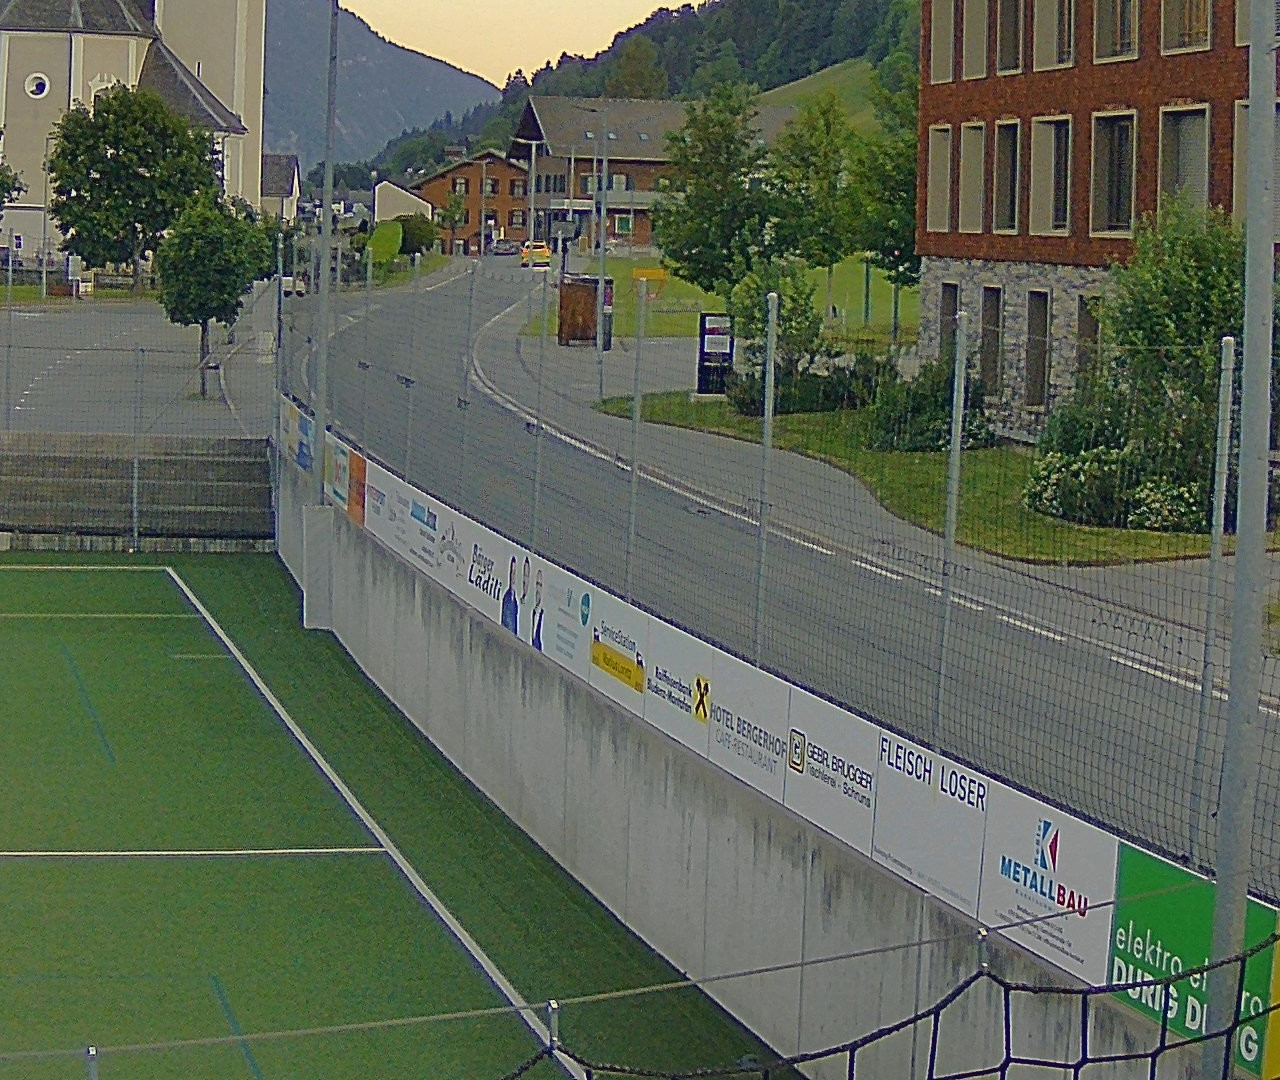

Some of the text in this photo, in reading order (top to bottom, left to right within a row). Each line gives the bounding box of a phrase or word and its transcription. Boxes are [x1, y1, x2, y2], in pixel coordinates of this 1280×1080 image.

[710, 702, 787, 760] HOTEL BERGERHOF
[806, 741, 873, 792] GEBR. BRUGGER
[880, 736, 987, 812] FLEISCH LOSER
[1000, 855, 1089, 918] METALLBAU
[1115, 920, 1183, 976] elektro
